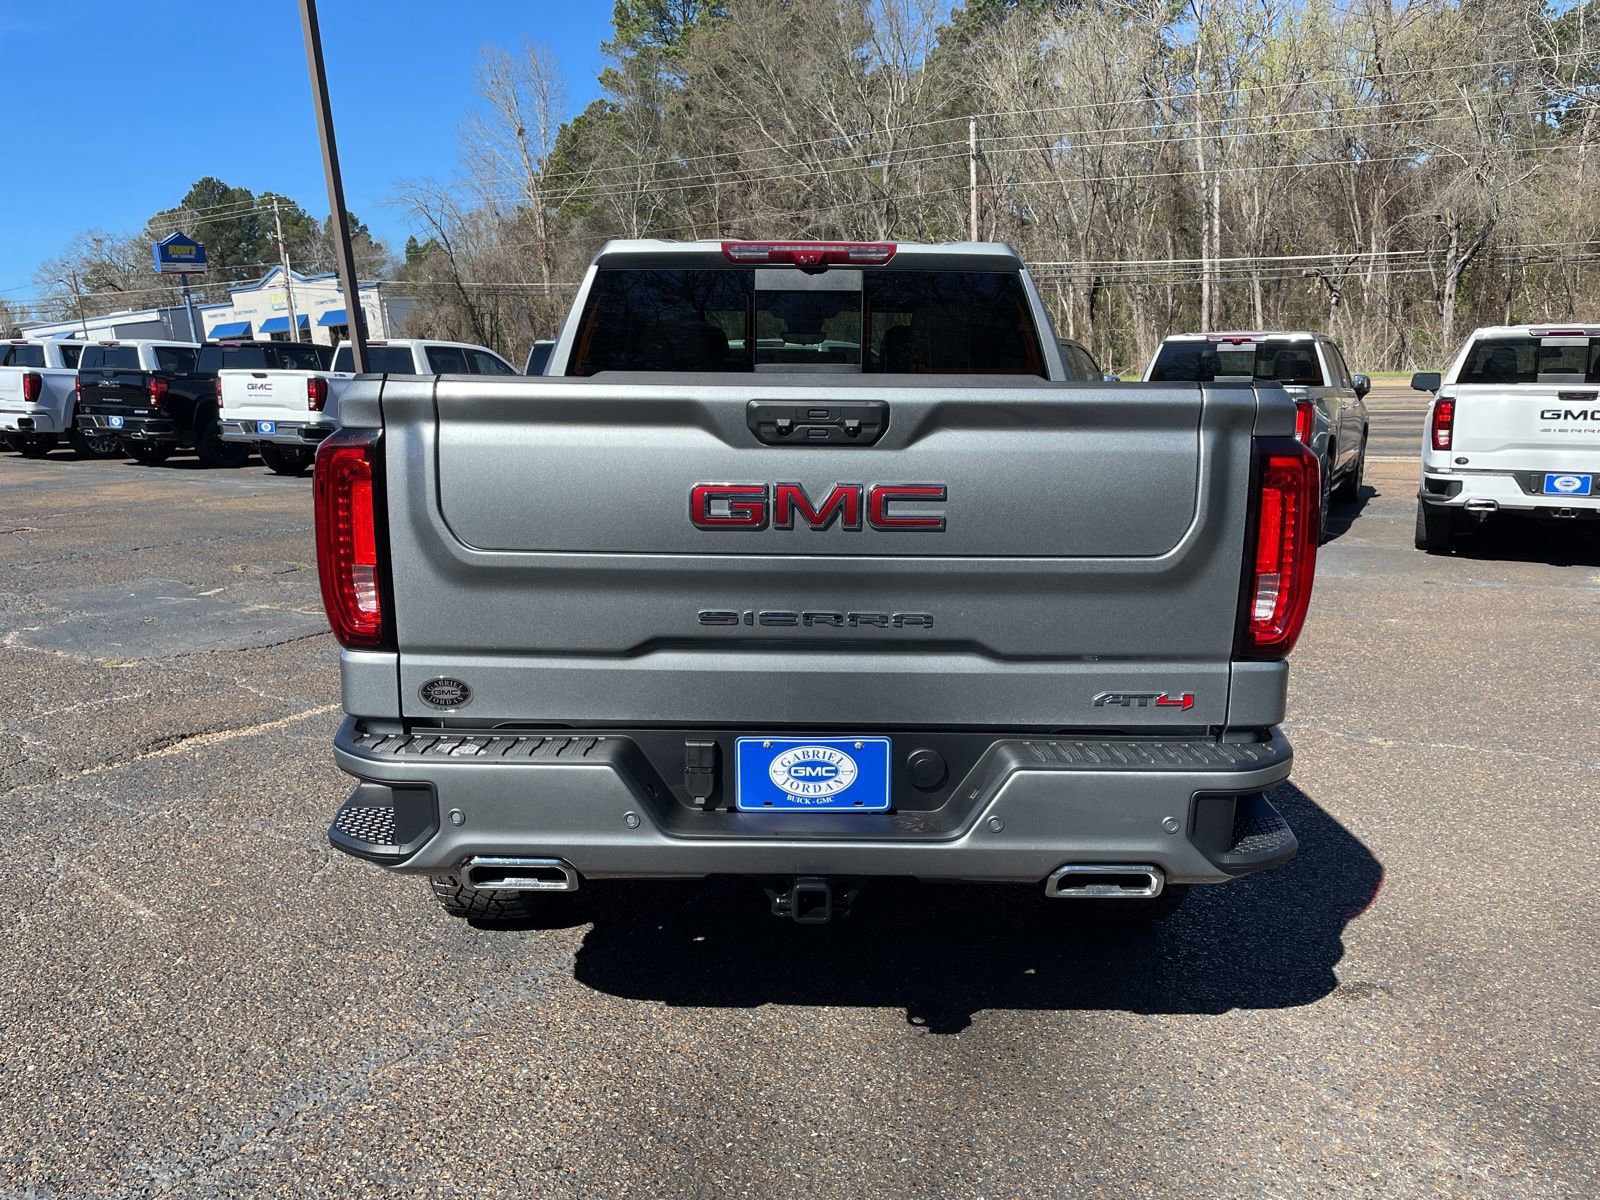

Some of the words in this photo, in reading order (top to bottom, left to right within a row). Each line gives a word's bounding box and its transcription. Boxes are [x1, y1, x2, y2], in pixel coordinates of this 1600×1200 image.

[247, 383, 273, 391] GMC
[689, 482, 948, 532] GMC
[698, 610, 934, 629] SIERRA
[426, 680, 463, 691] GABRIEL
[1093, 691, 1195, 712] AT4
[780, 749, 844, 768] GABRIEL
[790, 766, 836, 777] GMC
[780, 777, 844, 794] JORDAN
[786, 794, 811, 805] BUICK
[816, 796, 836, 804] GMC
